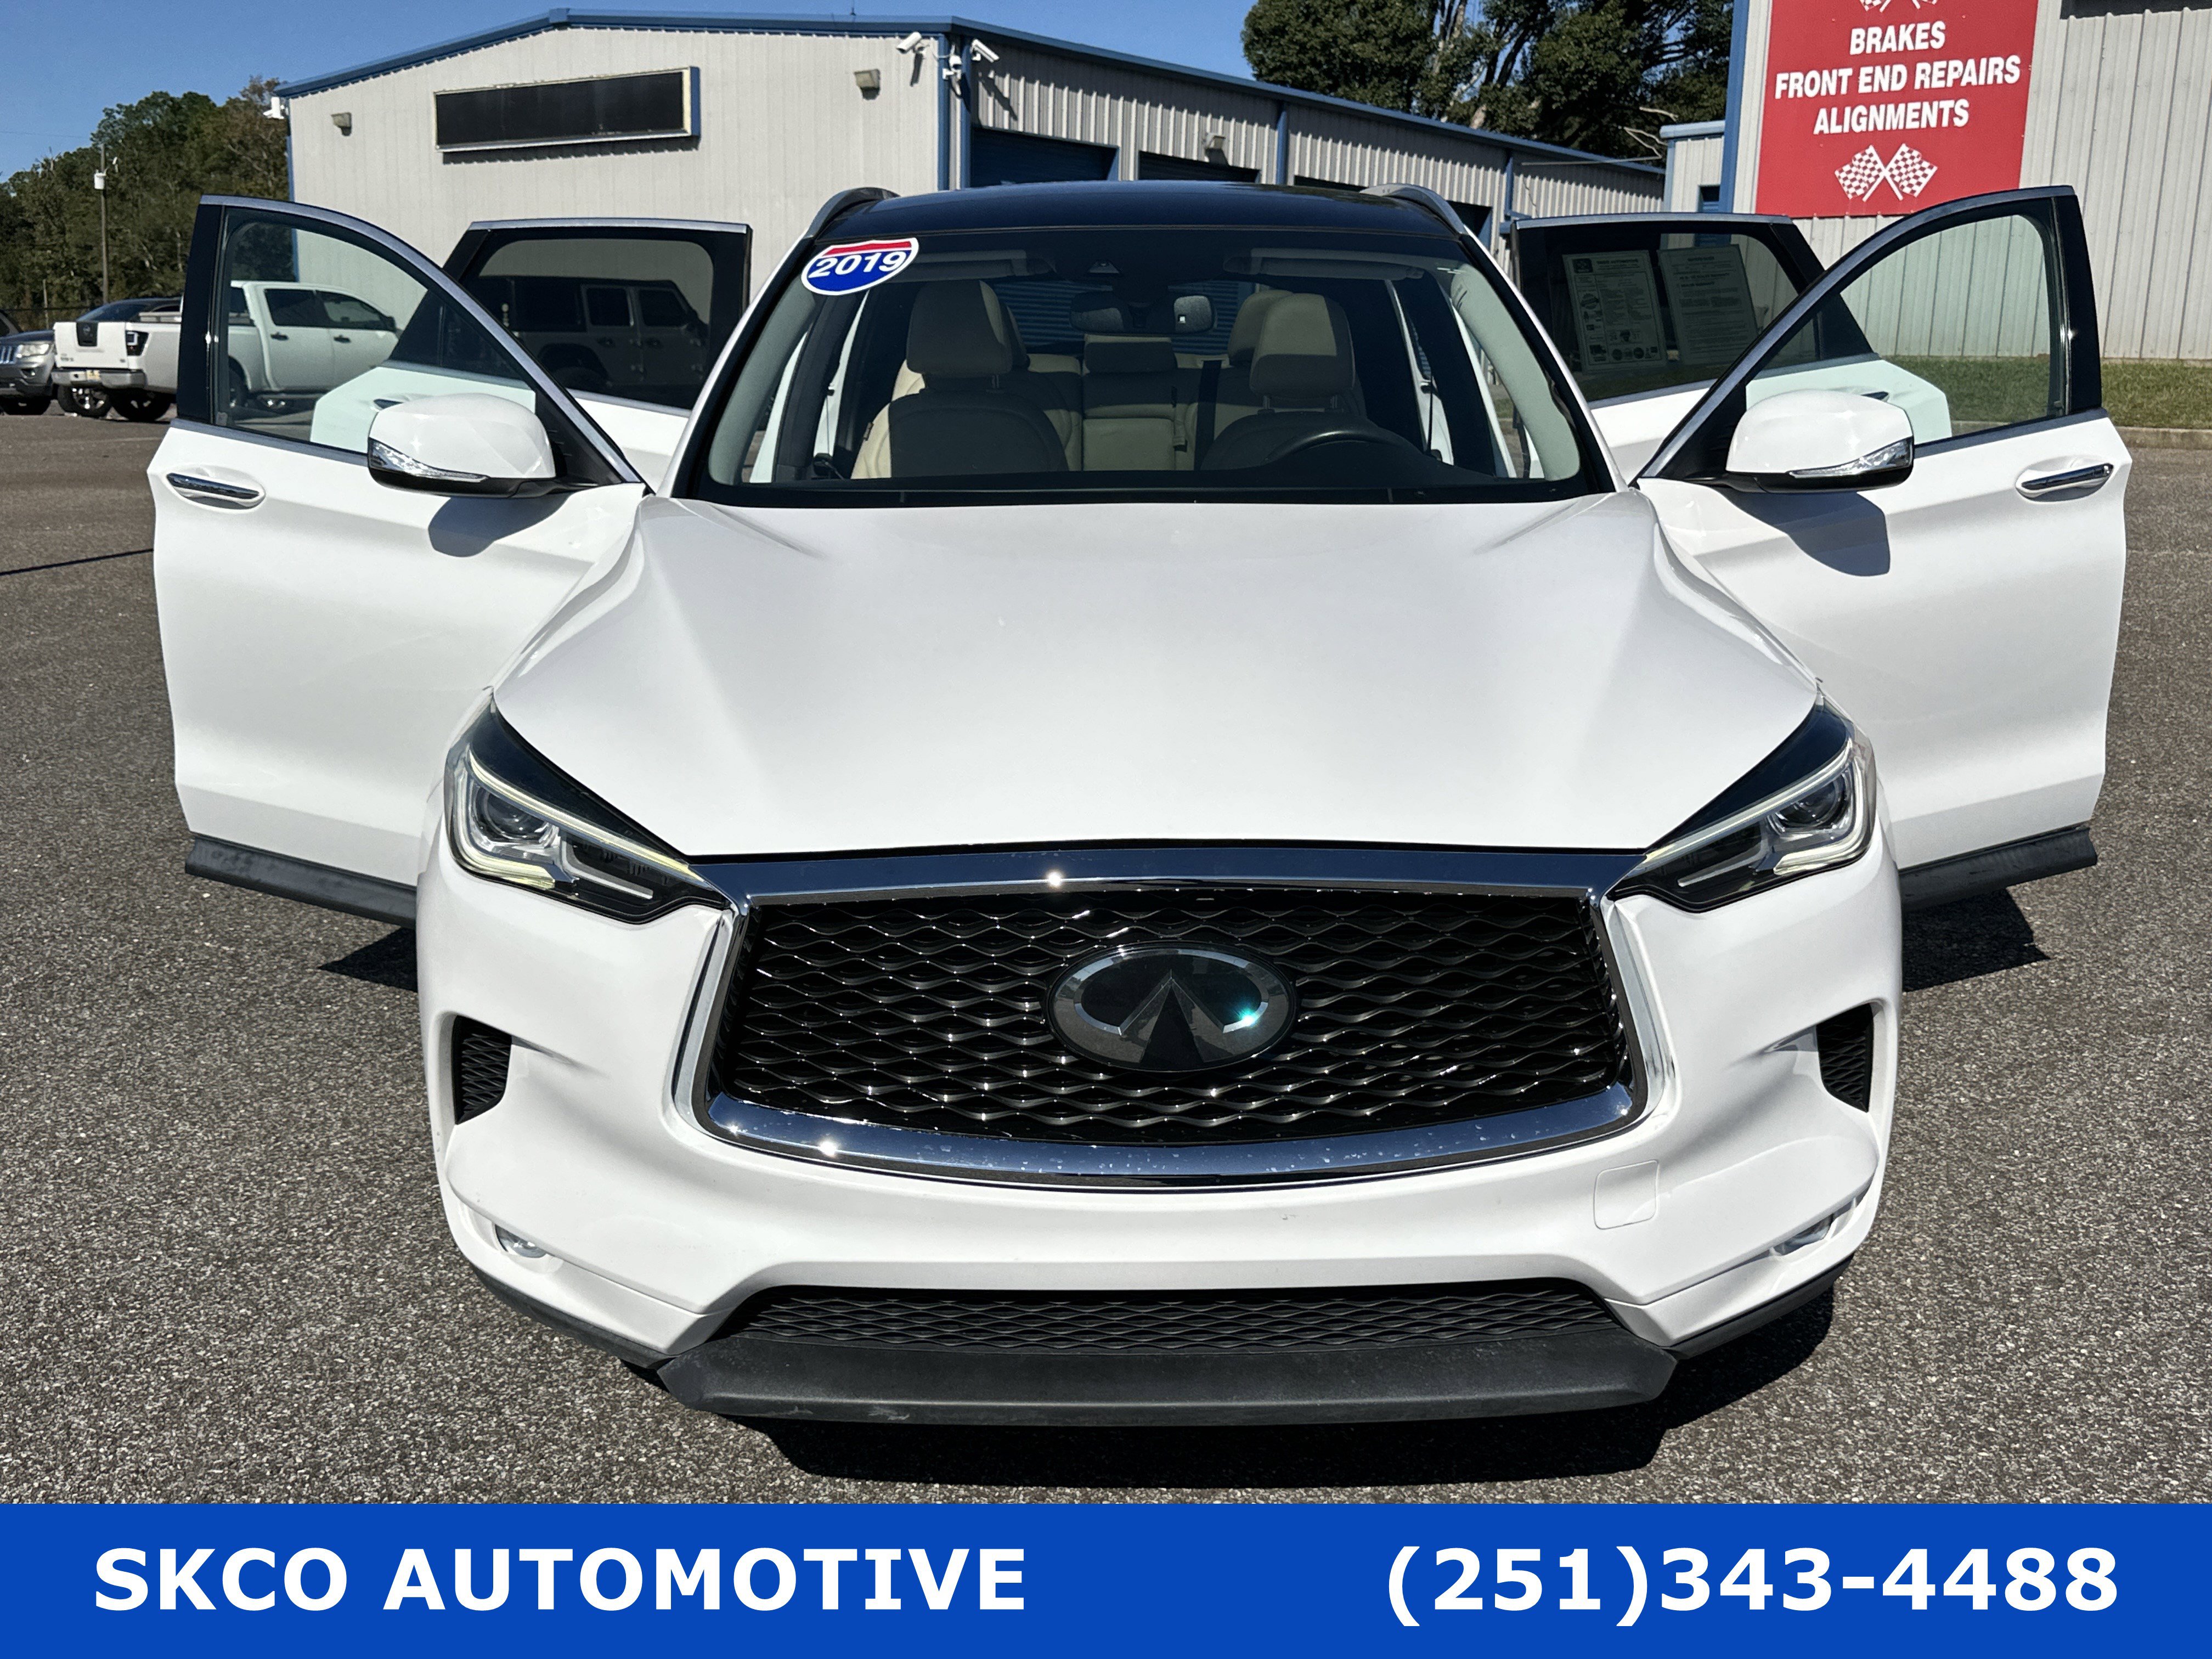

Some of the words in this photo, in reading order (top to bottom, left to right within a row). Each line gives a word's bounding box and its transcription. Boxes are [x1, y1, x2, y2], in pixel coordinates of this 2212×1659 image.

[1849, 20, 1946, 55] BRAKES
[1775, 67, 1853, 99] FRONT
[1858, 64, 1908, 93] END
[1914, 55, 2021, 90] REPAIRS
[1813, 99, 1970, 135] ALIGNMENTS
[808, 251, 906, 278] 2019
